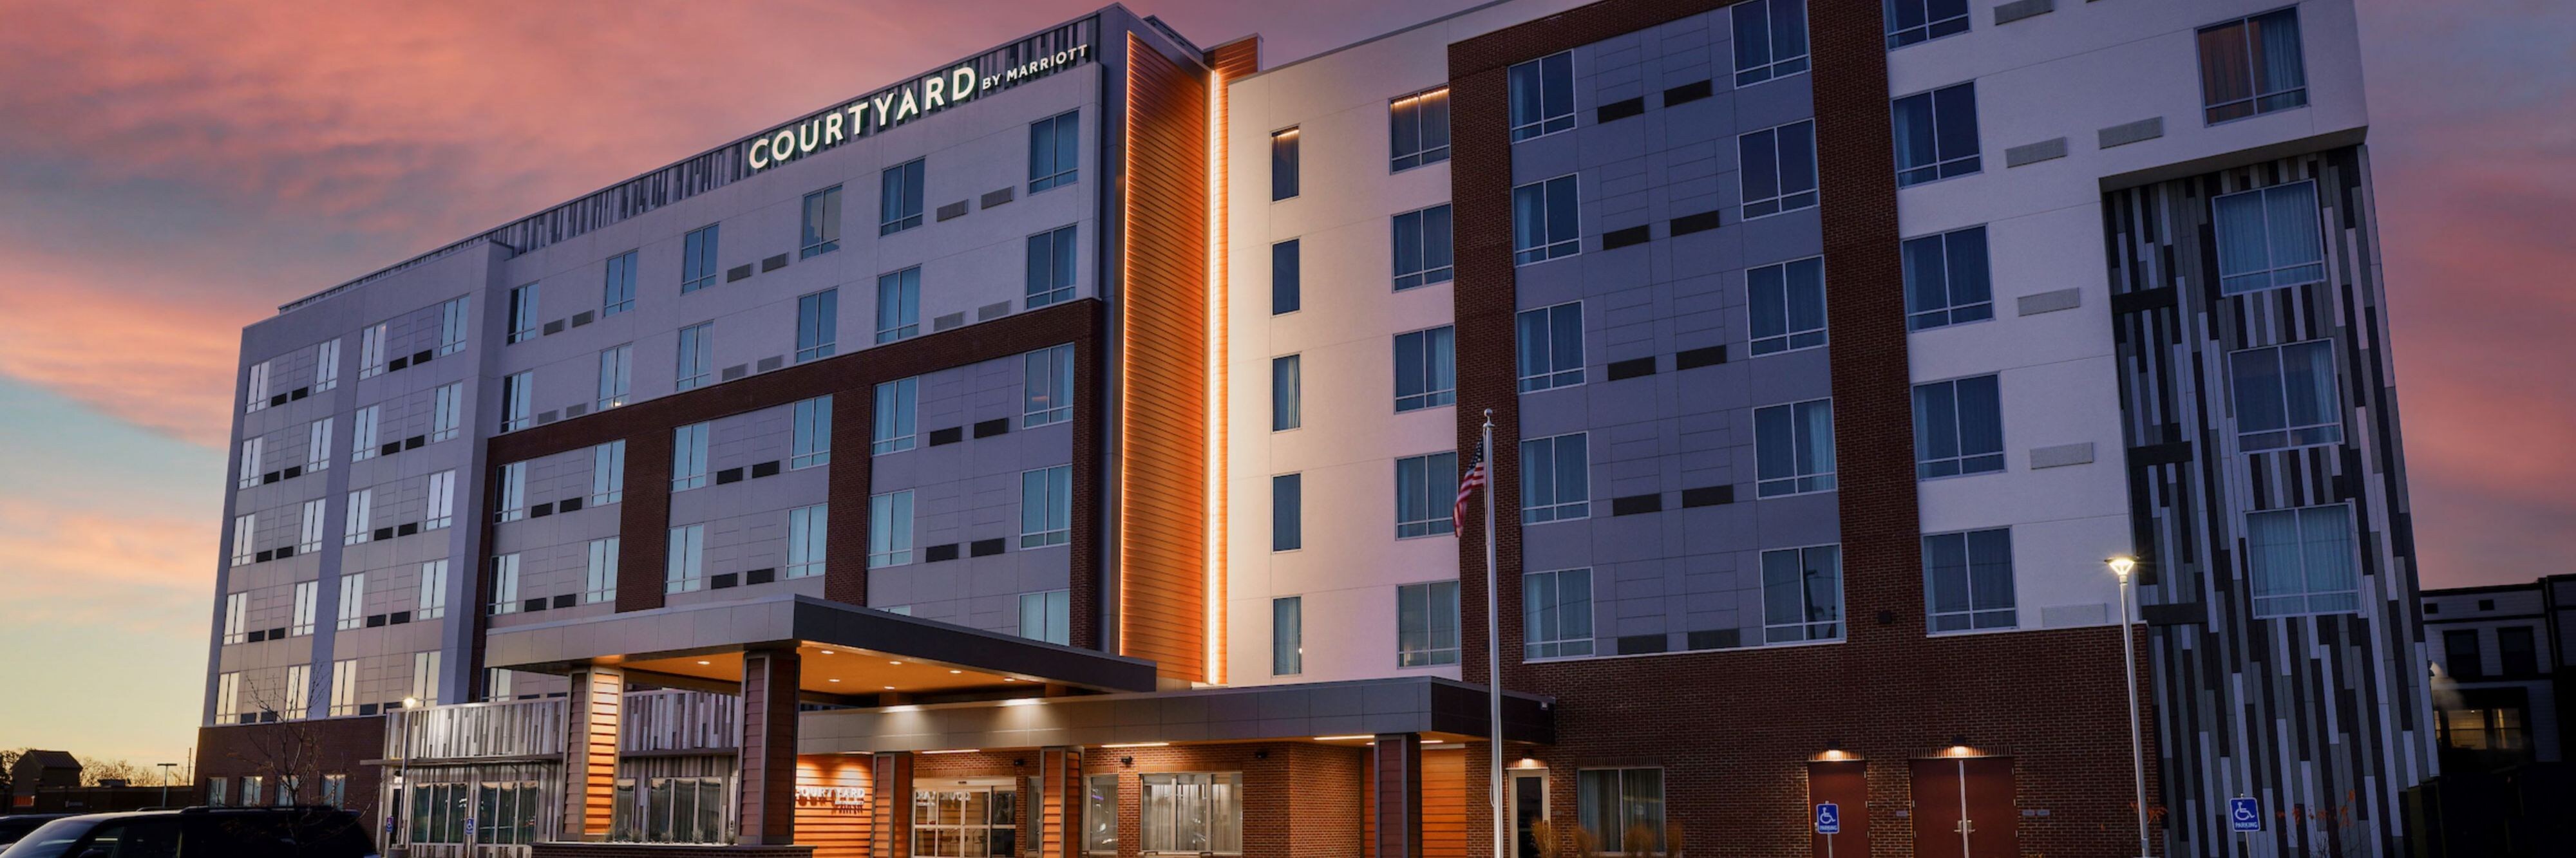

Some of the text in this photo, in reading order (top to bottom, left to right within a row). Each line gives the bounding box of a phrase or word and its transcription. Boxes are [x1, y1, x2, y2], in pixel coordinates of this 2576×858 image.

[748, 44, 1088, 169] COURTYARD BY MARRIOTT
